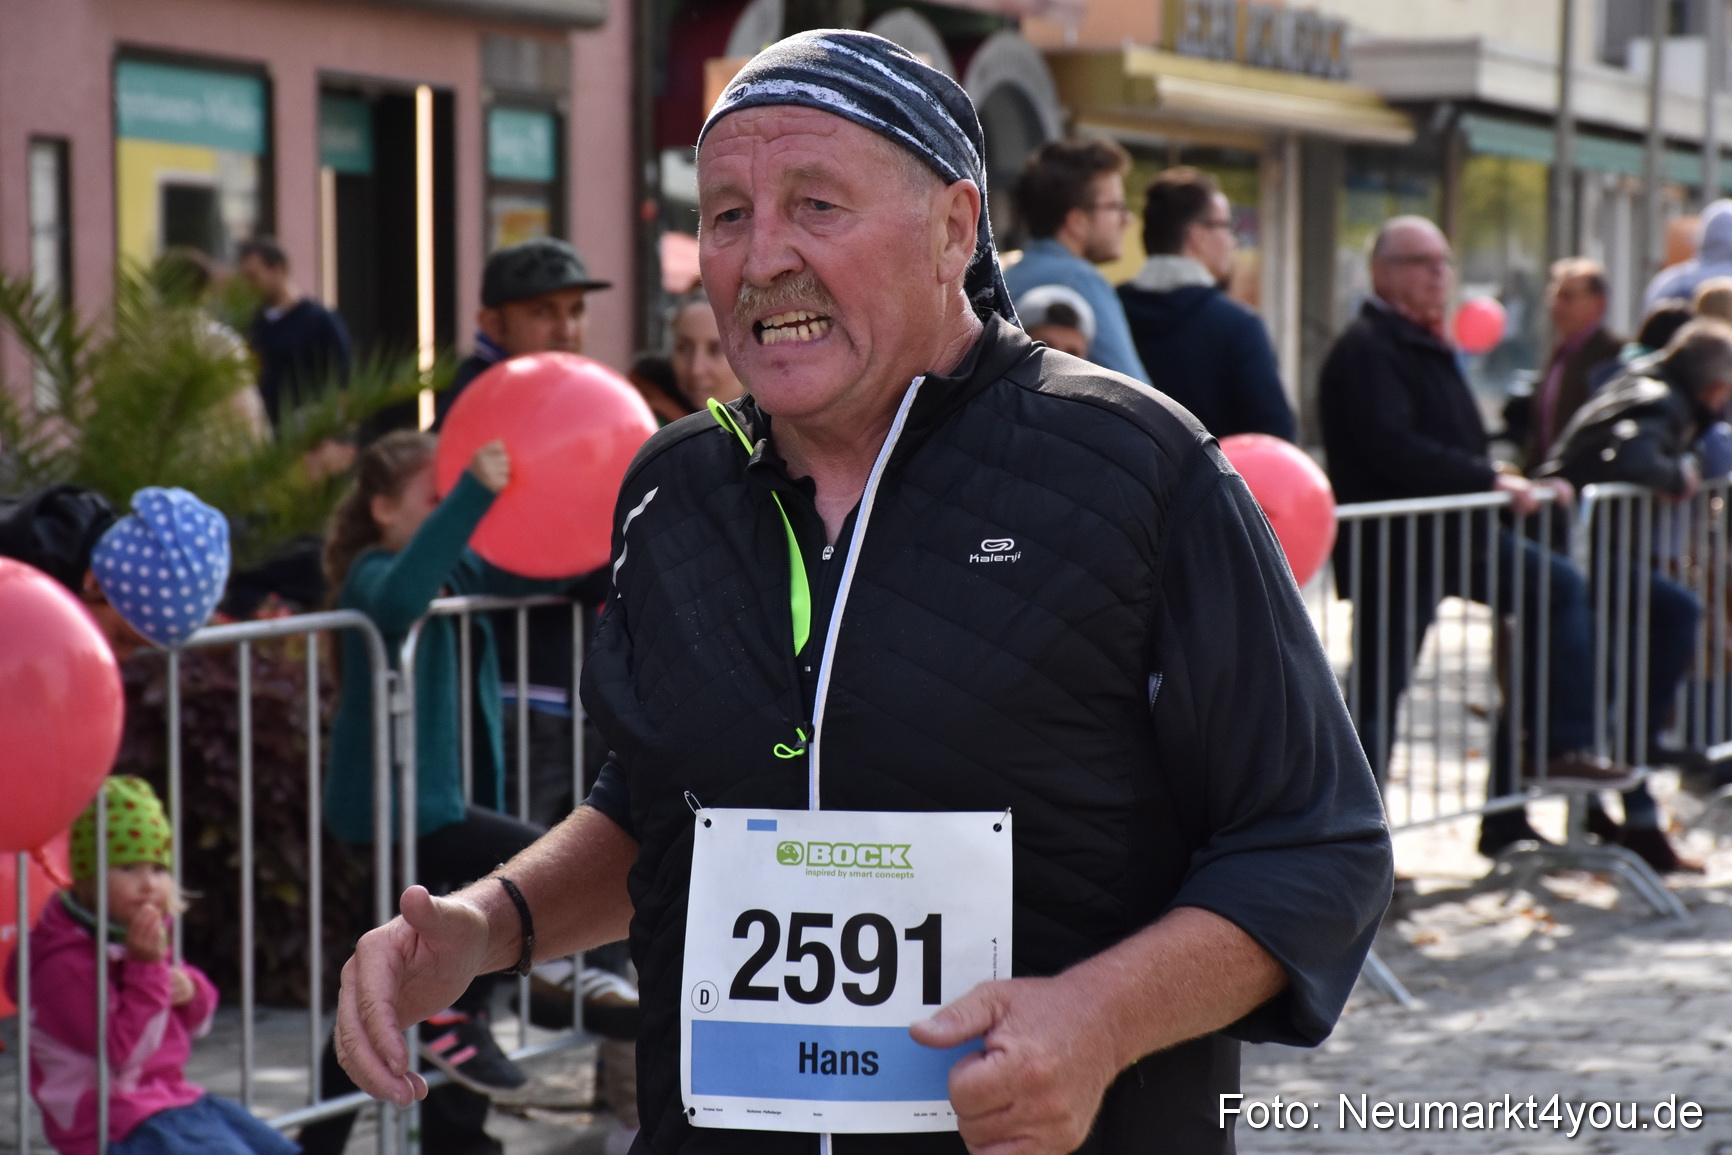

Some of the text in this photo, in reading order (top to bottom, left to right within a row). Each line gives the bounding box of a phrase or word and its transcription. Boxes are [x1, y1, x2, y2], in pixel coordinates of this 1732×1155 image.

[969, 551, 1021, 563] Kalenji
[806, 842, 913, 869] BOCK
[805, 868, 914, 880] inspired by smart concepts
[728, 909, 942, 1007] 2591
[700, 989, 709, 1005] D
[799, 1041, 879, 1076] Hans
